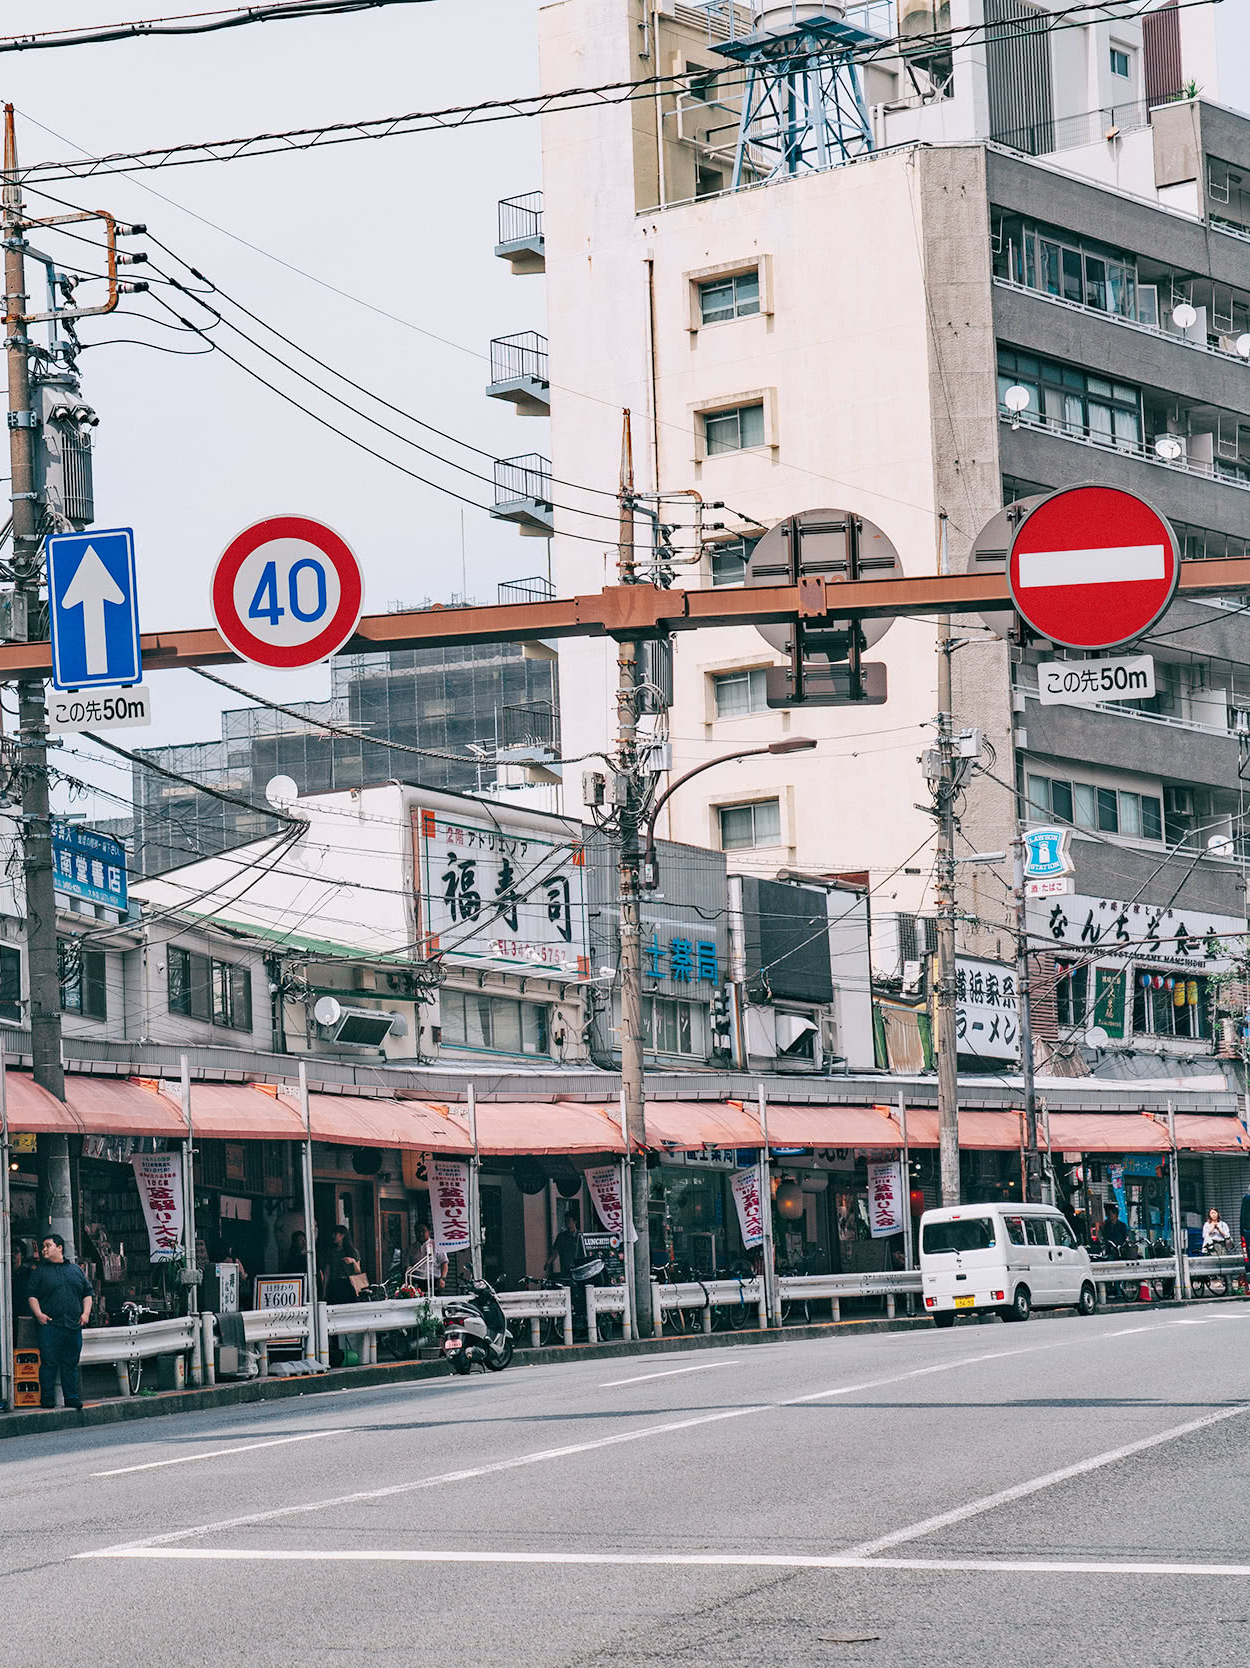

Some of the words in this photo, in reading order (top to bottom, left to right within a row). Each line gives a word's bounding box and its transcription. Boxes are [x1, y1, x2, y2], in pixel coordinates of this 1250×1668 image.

[249, 558, 326, 626] 40
[1047, 667, 1148, 693] この先50m
[55, 699, 145, 724] この先50m
[1028, 835, 1058, 843] LAWSON
[1030, 862, 1060, 870] STATION
[264, 1292, 296, 1307] ¥600
